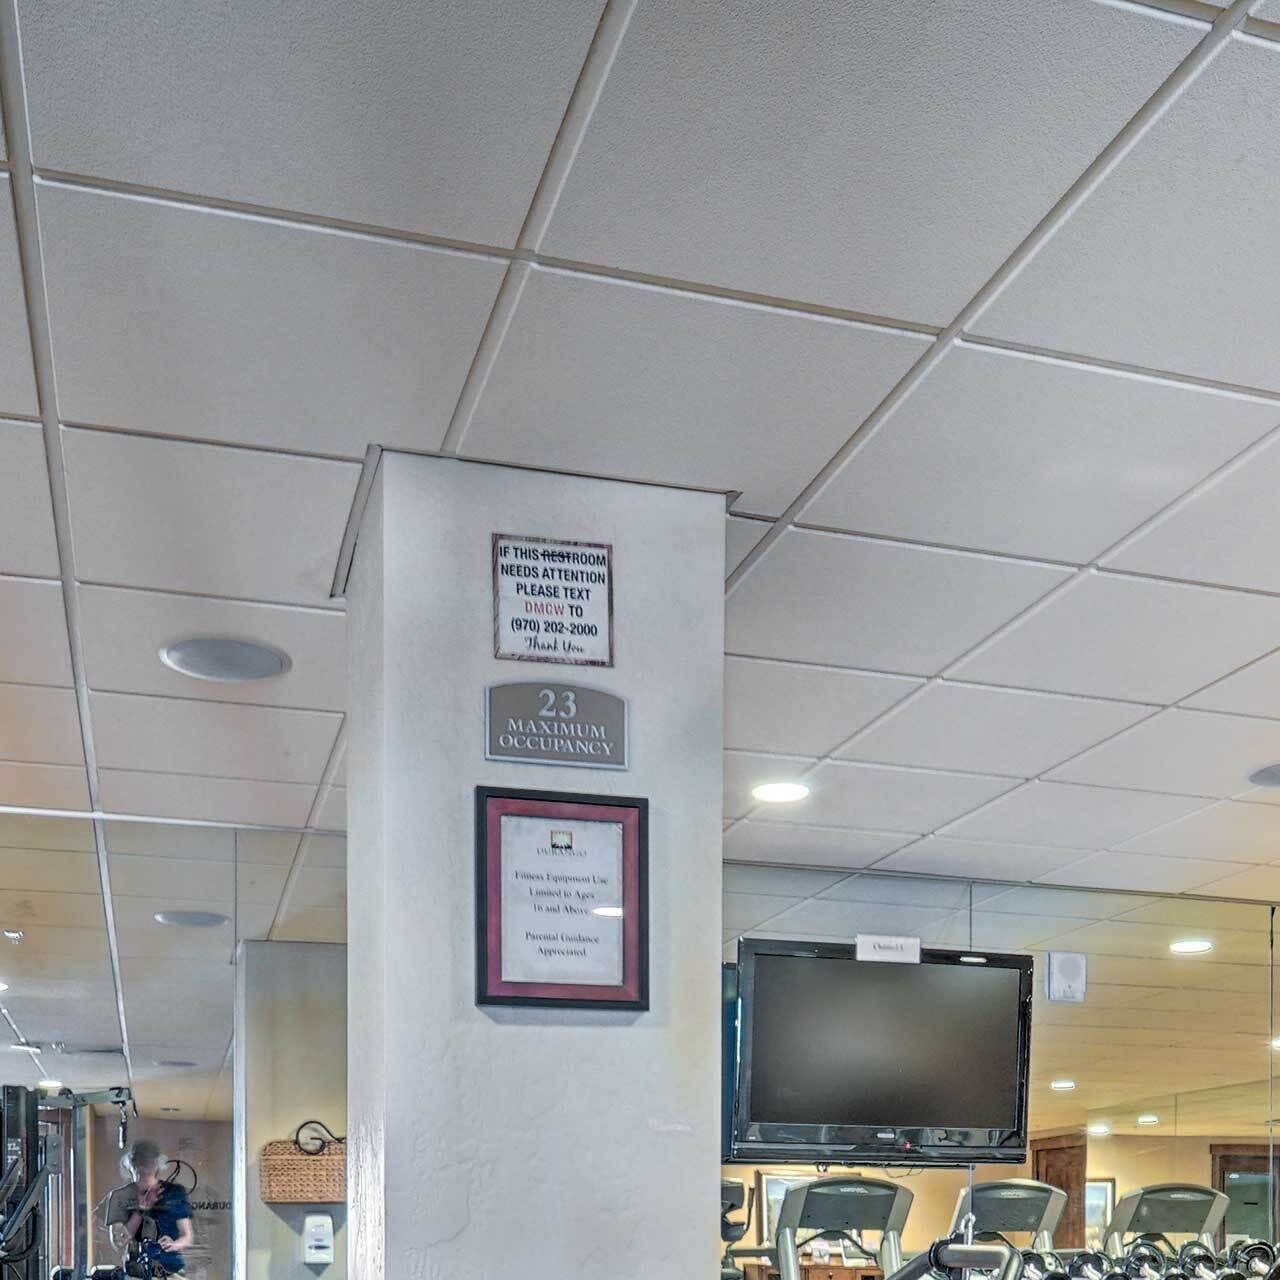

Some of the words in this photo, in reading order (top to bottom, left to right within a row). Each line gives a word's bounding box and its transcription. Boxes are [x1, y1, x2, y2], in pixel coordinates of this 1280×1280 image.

[500, 547, 510, 557] IF
[513, 547, 539, 560] THIS
[501, 564, 539, 578] NEEDS
[542, 568, 606, 584] ATTENTION
[516, 583, 560, 598] PLEASE
[562, 587, 592, 600] TEXT
[525, 602, 564, 615] DMCW
[568, 604, 583, 618] TO
[511, 617, 540, 634] (970)
[544, 620, 598, 637] 202-2000
[524, 635, 558, 651] Thank
[562, 640, 584, 653] You
[539, 688, 577, 719] 23
[508, 718, 606, 739] MAXIMUM
[499, 734, 613, 755] OCCUPANCY
